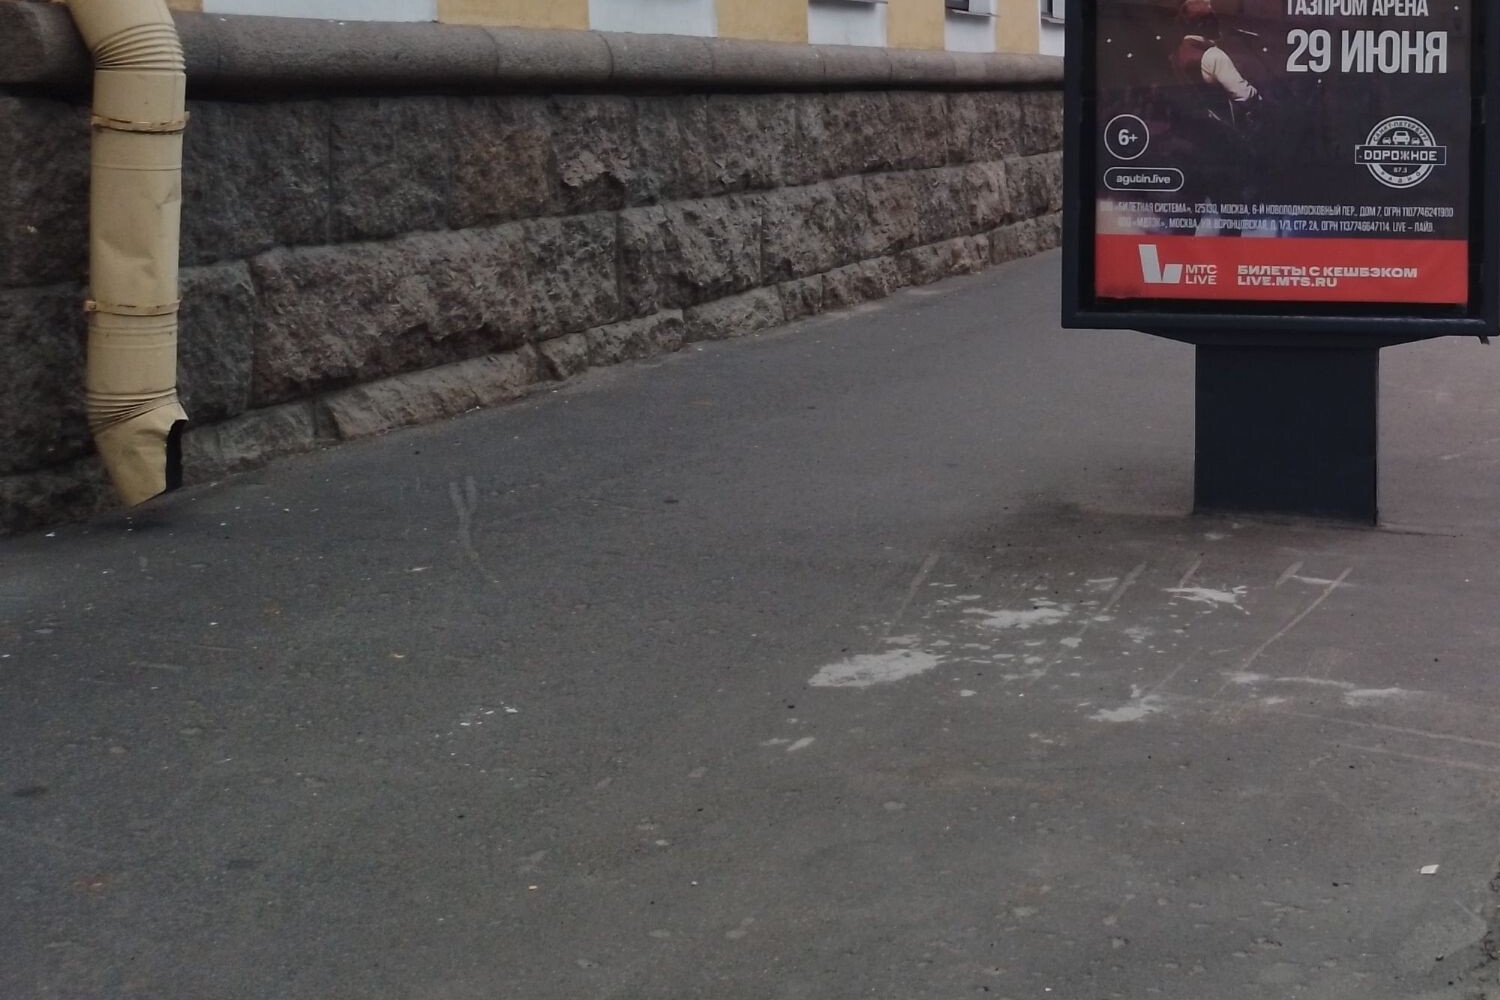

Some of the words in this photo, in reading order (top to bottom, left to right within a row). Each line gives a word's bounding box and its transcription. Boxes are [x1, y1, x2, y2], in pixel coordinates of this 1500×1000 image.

[1286, 28, 1332, 73] 29
[1341, 30, 1448, 74] ИЮНЯ
[1118, 129, 1138, 146] 6+
[1364, 150, 1438, 161] ДОРОЖНОЕ
[1116, 174, 1171, 185] agutin.live
[1359, 206, 1376, 217] ДОМ
[1383, 206, 1401, 217] ОГРН
[1392, 221, 1407, 232] LIVE
[1185, 264, 1218, 275] МТС
[1237, 265, 1306, 276] БИЛЕТЫ
[1309, 266, 1321, 276] С
[1323, 267, 1418, 278] КЕШБЭКОМ
[1185, 275, 1217, 285] LIVE
[1237, 276, 1338, 287] LIVE.MTS.RU
